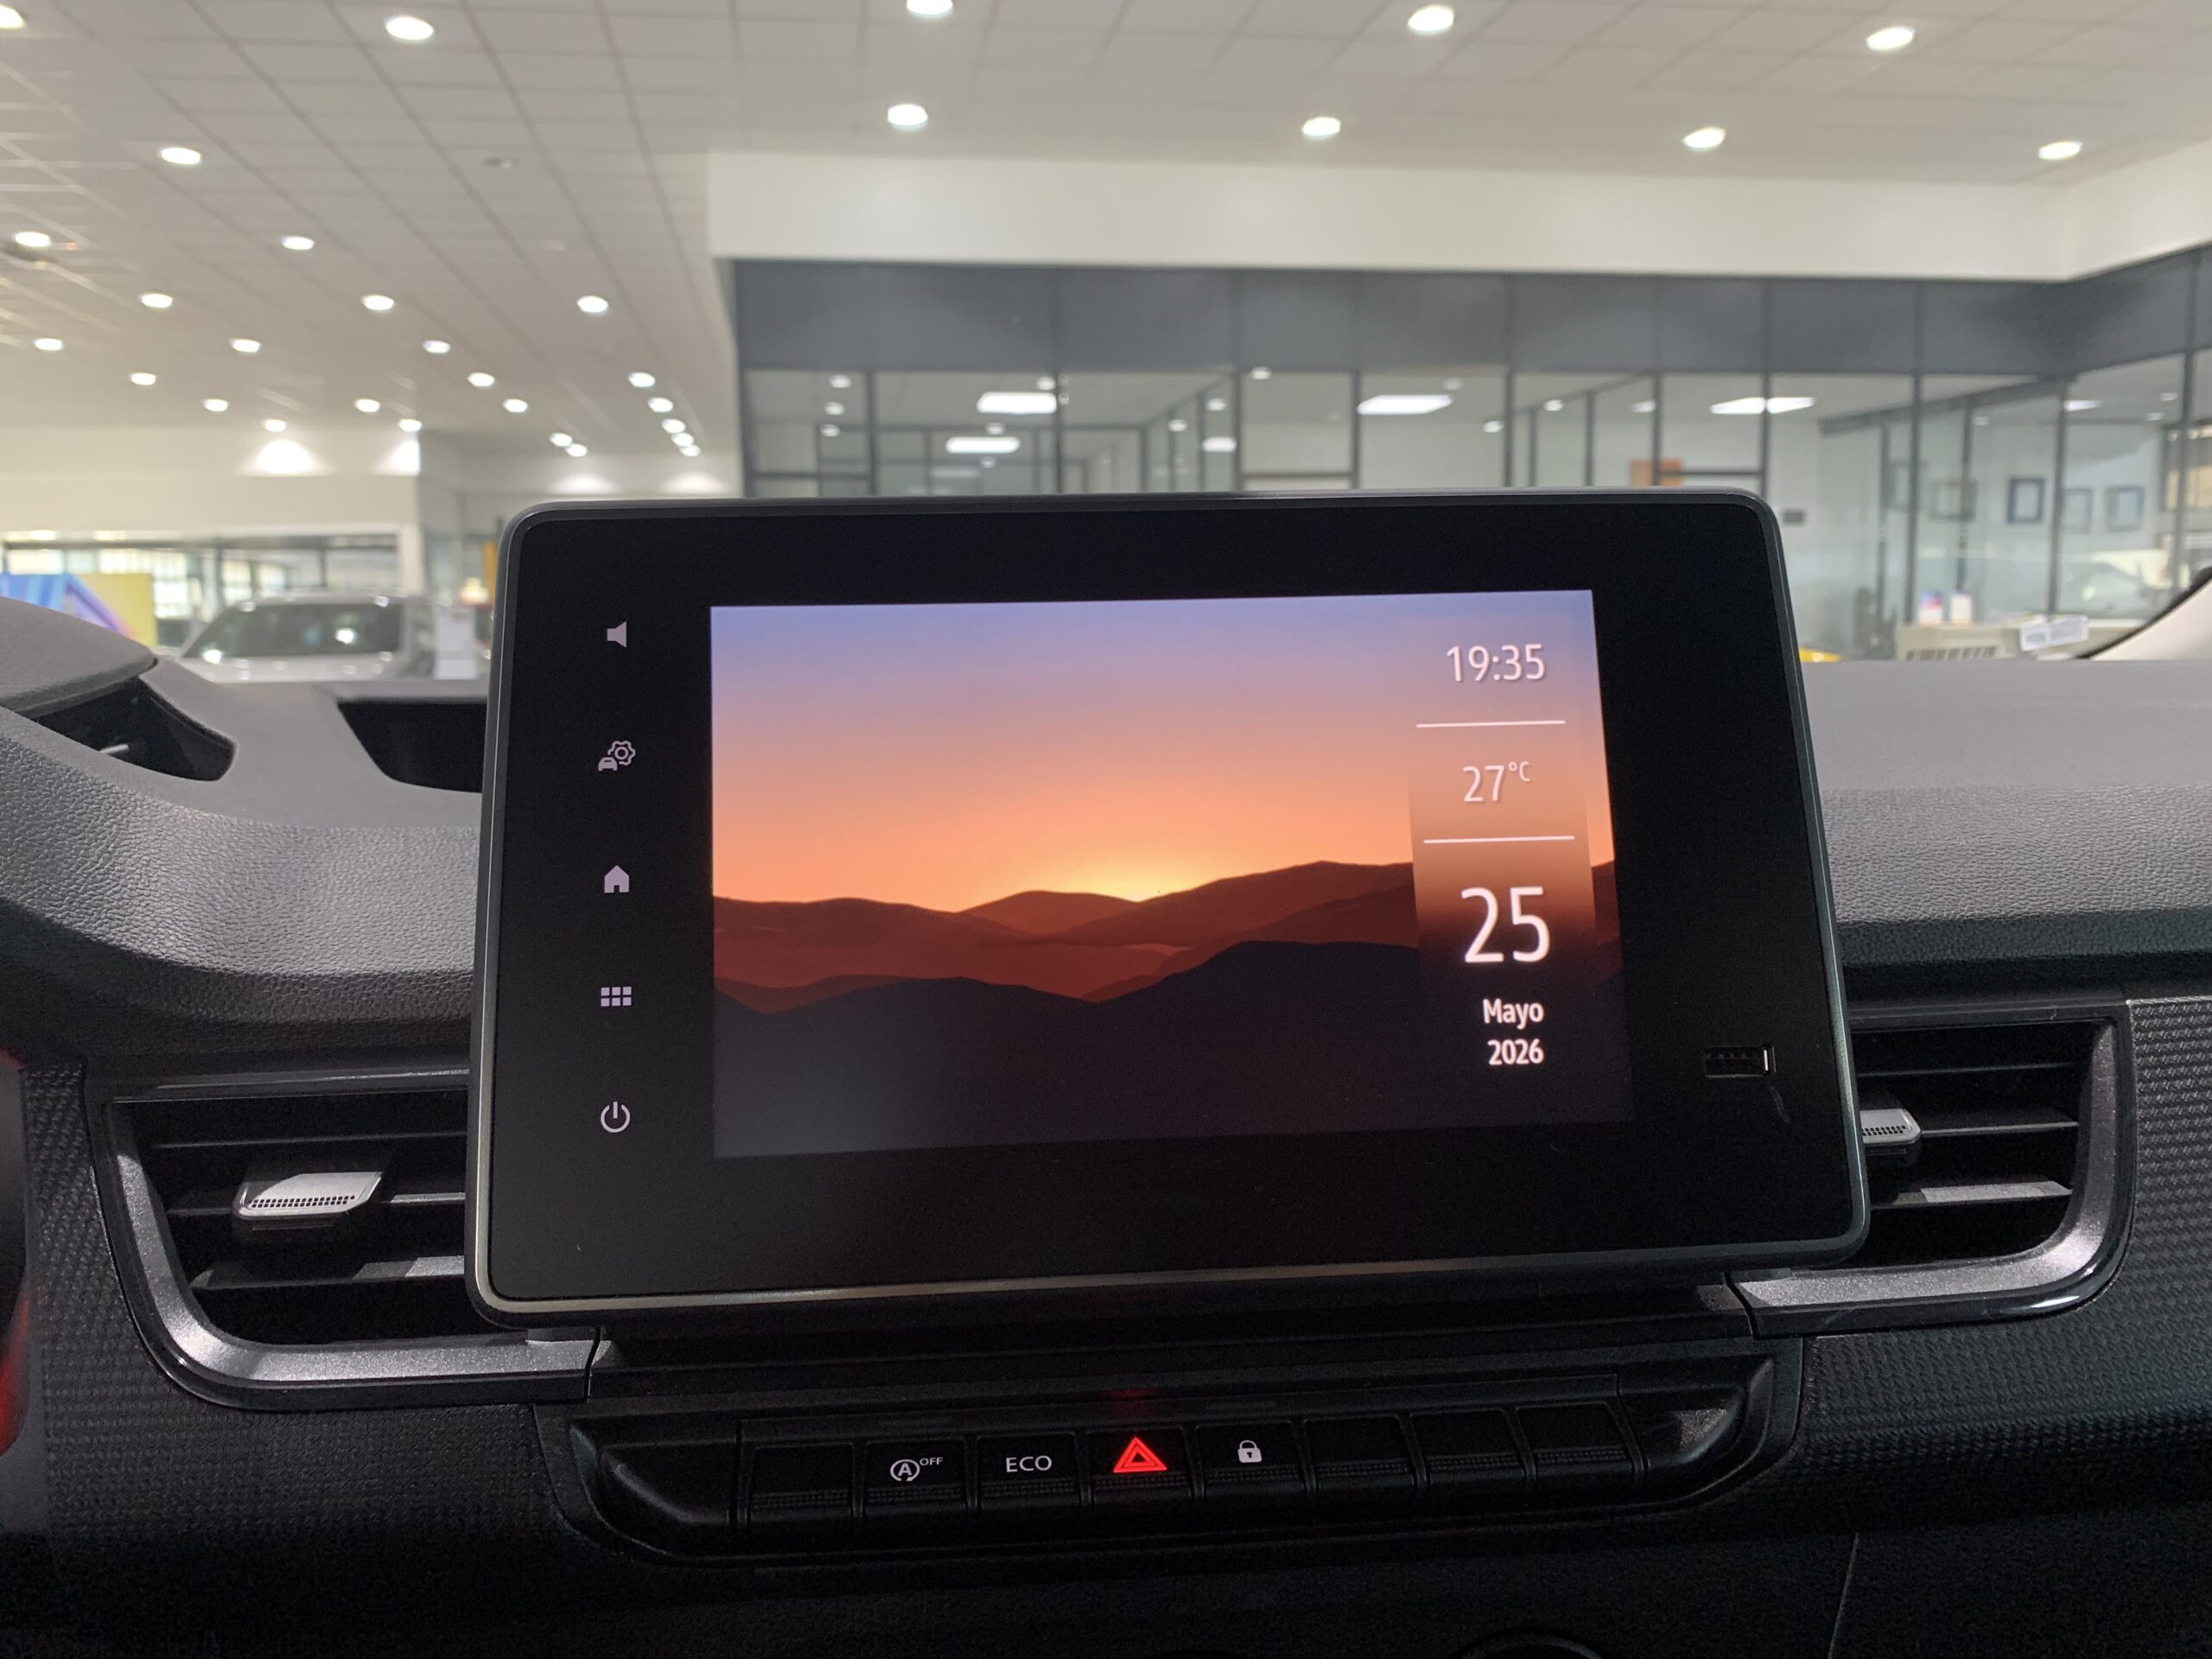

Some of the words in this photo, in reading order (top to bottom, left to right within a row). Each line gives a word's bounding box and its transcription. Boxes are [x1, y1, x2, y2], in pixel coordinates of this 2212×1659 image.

[1446, 644, 1547, 683] 19:35
[1460, 886, 1551, 964] 25
[1483, 998, 1545, 1030] Mayo
[1487, 1039, 1545, 1066] 2026
[919, 1457, 944, 1466] OFF
[1006, 1455, 1052, 1472] ECO
